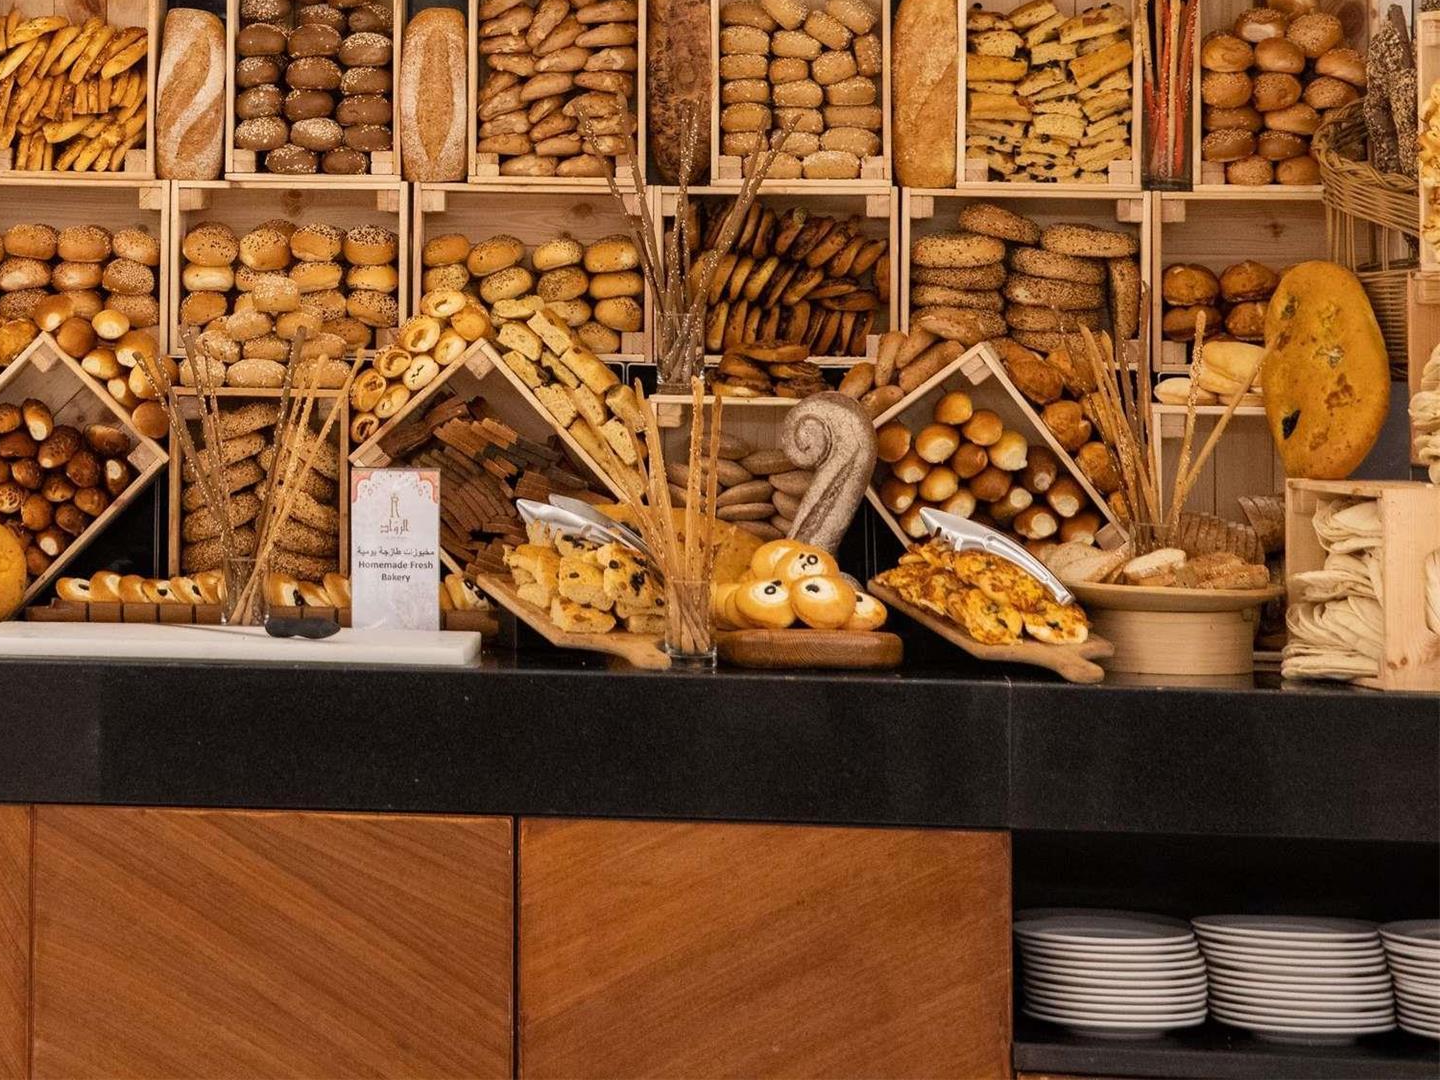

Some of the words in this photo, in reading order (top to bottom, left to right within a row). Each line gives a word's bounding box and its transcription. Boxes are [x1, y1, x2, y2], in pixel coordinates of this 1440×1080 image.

[358, 561, 407, 569] Homemade
[410, 561, 434, 569] Fresh
[381, 573, 410, 582] Bakery
